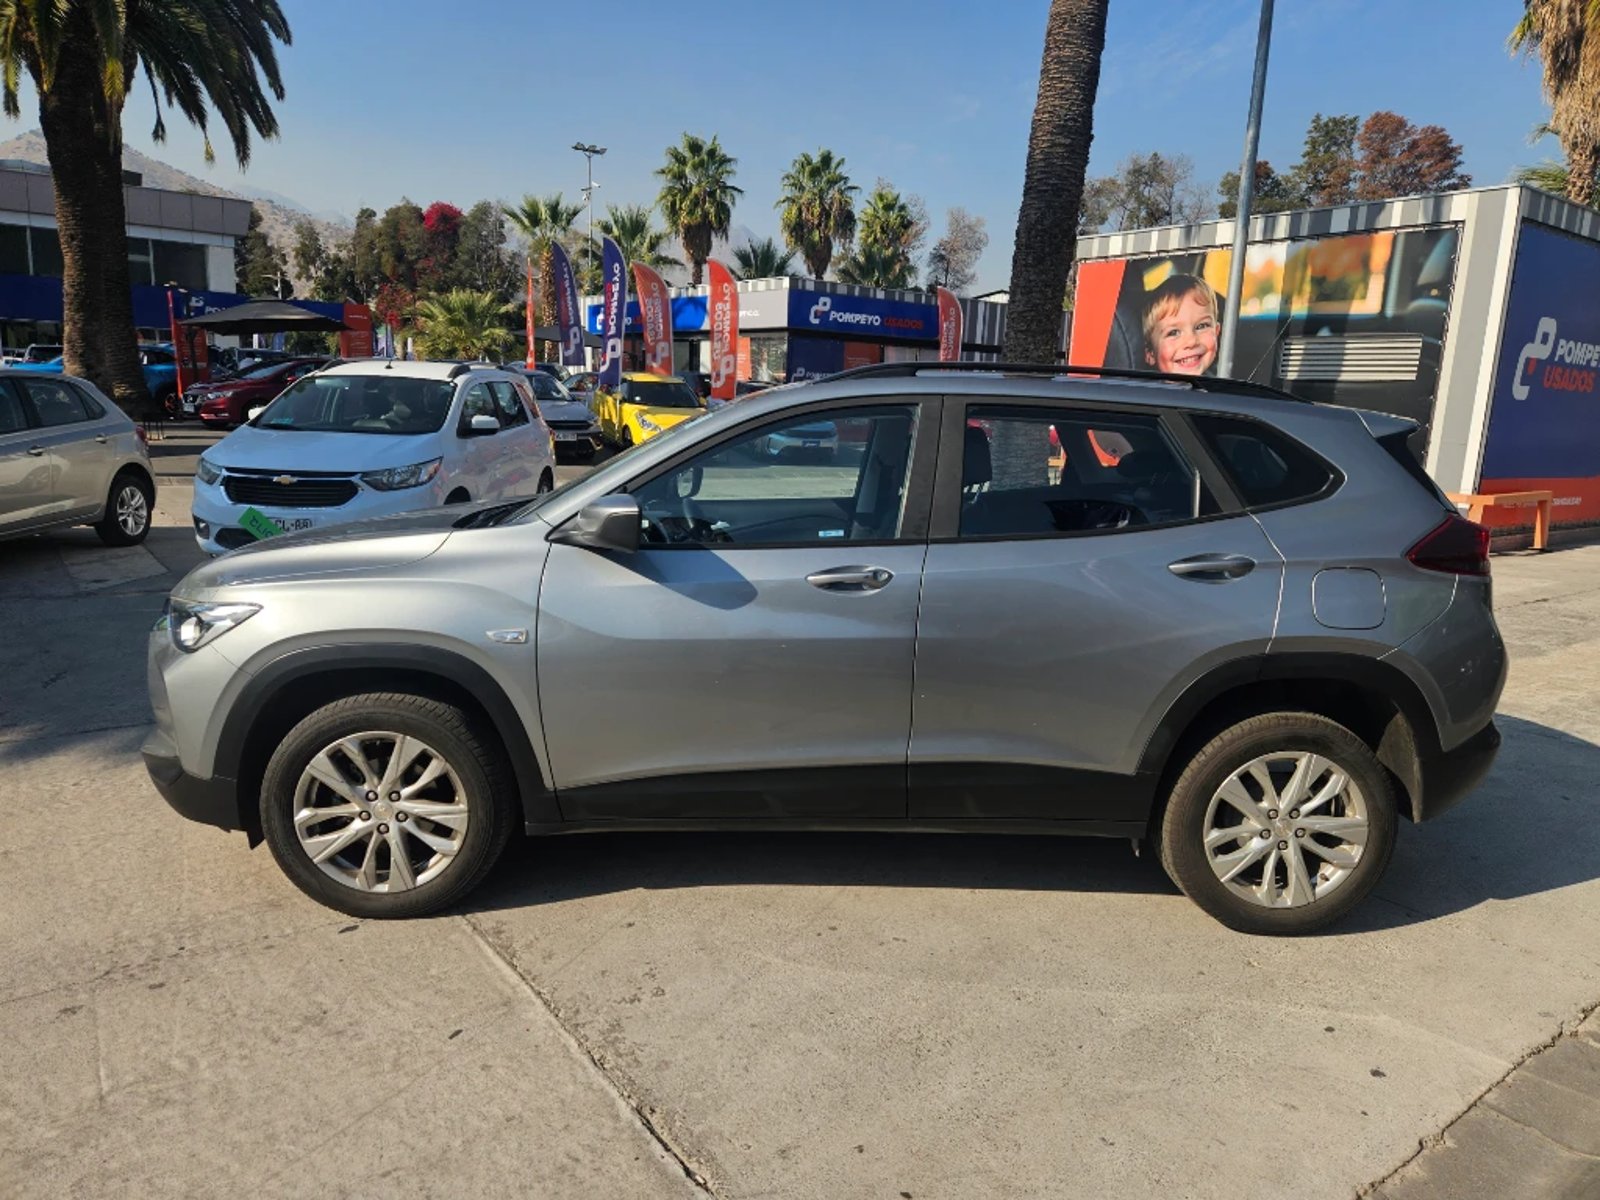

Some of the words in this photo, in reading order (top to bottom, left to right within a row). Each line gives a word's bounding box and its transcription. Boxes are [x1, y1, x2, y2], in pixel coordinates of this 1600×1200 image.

[829, 310, 881, 326] POMPEYO
[1554, 338, 1600, 367] POMPE
[1543, 365, 1596, 392] USADOS
